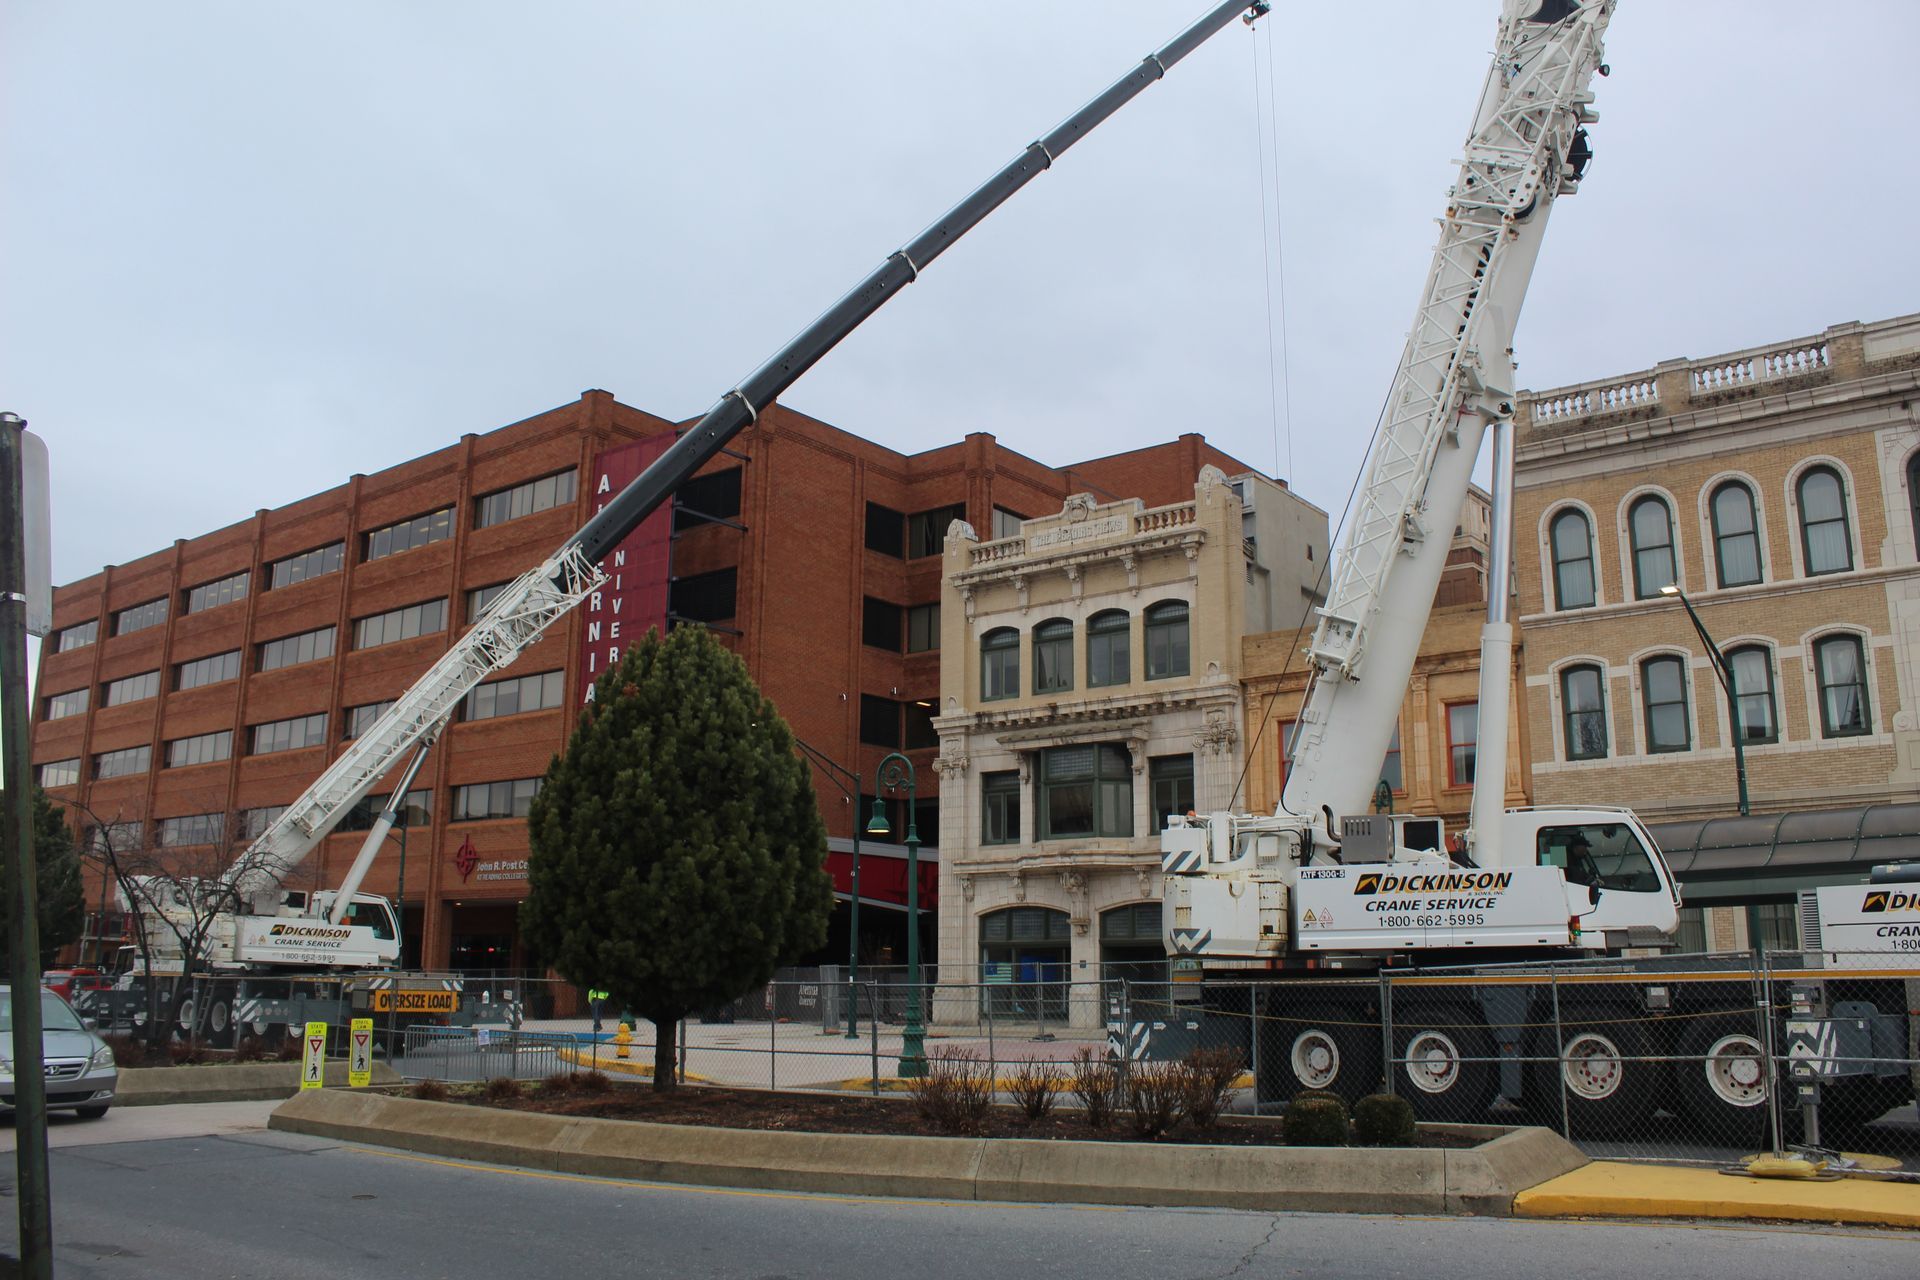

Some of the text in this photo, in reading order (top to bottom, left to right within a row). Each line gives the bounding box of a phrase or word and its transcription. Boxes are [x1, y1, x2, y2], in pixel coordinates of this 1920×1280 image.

[1056, 527, 1092, 543] READING
[1095, 520, 1123, 536] NEWS
[583, 473, 610, 704] ARNIA
[477, 860, 530, 872] John R. Post Ce
[1302, 871, 1316, 879] ATF
[1380, 872, 1513, 893] DICKINSON
[1365, 898, 1497, 912] CRANE SERVICE
[1888, 893, 1920, 912] DI
[284, 926, 351, 939] DICKINSON
[274, 938, 304, 947] CRANE
[306, 939, 342, 948] SERVICE
[428, 994, 451, 1009] LOAD
